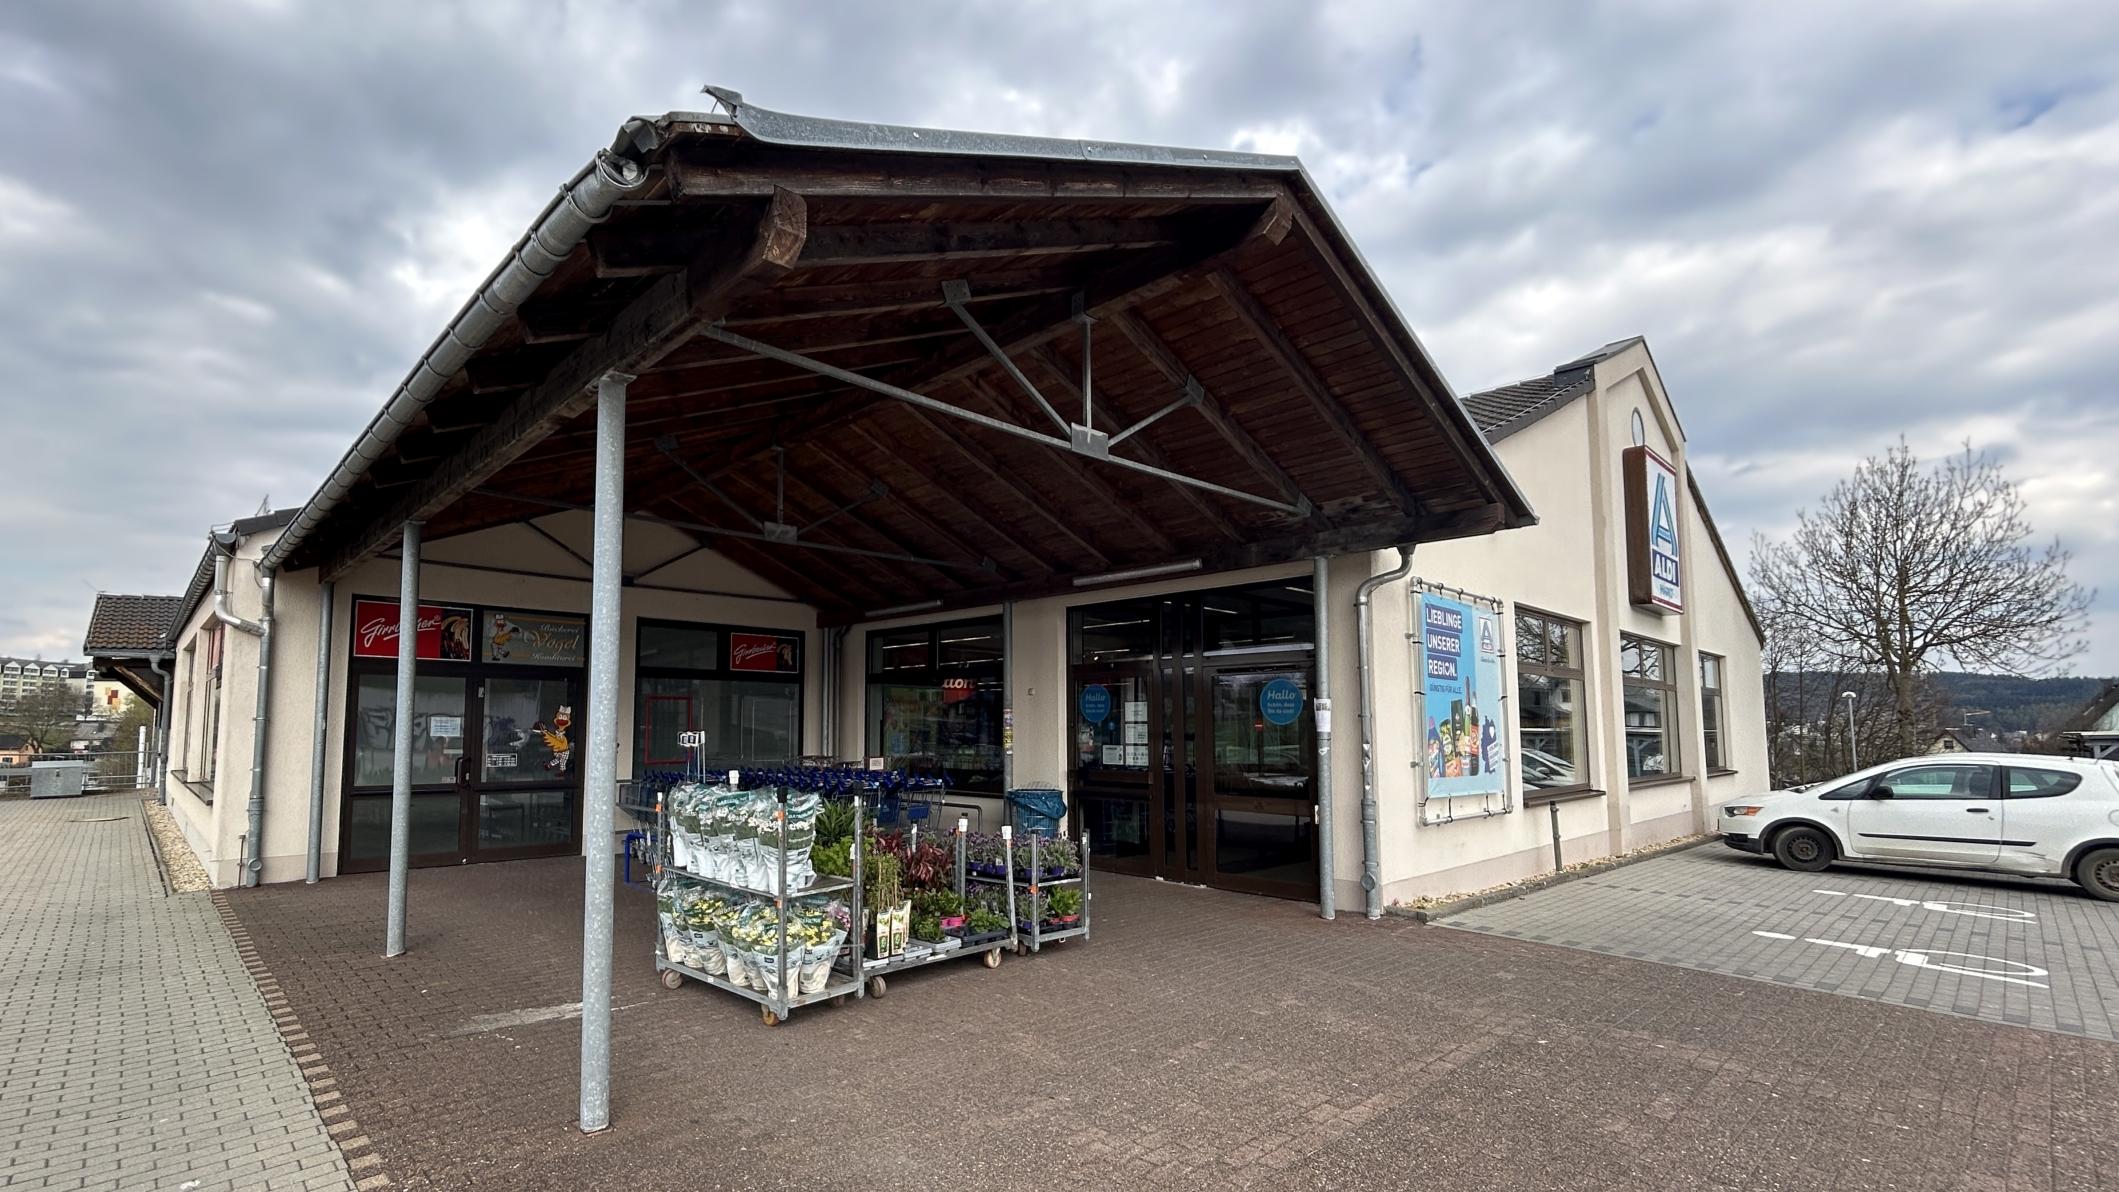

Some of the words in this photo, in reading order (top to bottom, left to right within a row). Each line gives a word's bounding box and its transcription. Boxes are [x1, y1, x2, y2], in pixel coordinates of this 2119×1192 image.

[1654, 553, 1677, 583] ALDI
[1426, 607, 1462, 629] LIEBLINGE
[532, 630, 580, 657] Vogel
[1427, 634, 1460, 653] UNSERER
[1428, 659, 1457, 677] REGION.
[1267, 688, 1296, 701] Hallo
